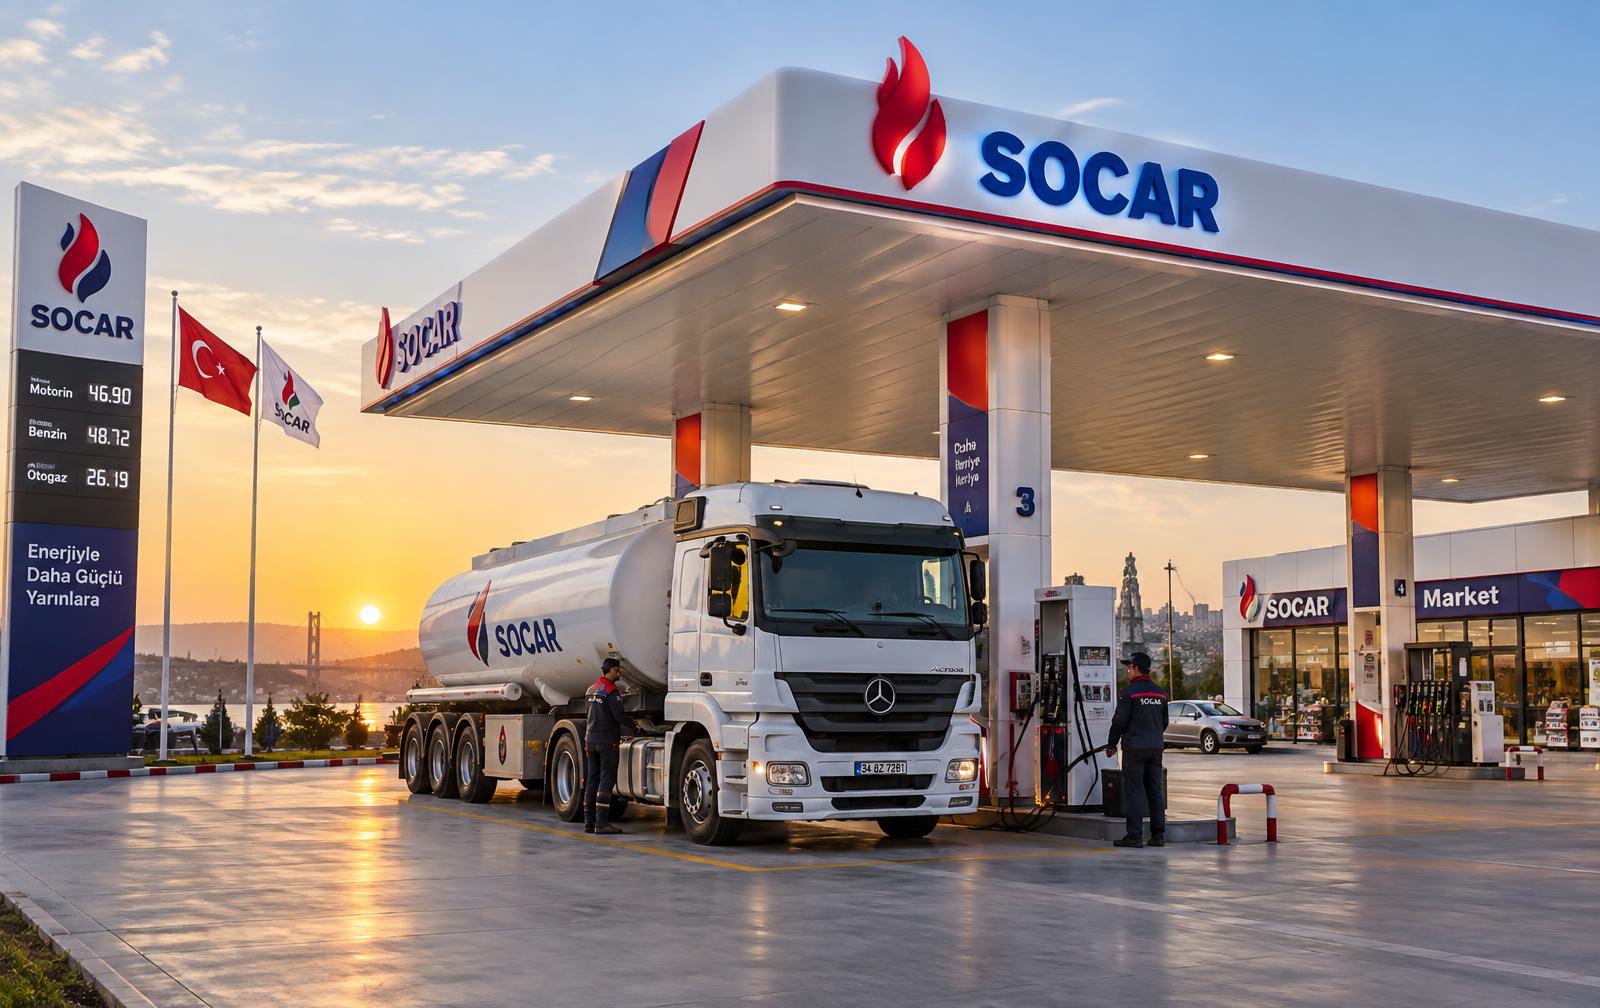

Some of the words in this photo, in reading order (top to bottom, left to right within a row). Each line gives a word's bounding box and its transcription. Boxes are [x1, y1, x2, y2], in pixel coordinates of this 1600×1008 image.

[979, 131, 1219, 232] SOCAR
[31, 304, 134, 339] SOCAR
[395, 301, 460, 372] SOCAR
[29, 383, 73, 399] Motorin
[89, 384, 132, 405] 46.90
[28, 425, 67, 441] Benzin
[87, 426, 130, 447] 48.72
[27, 469, 68, 484] Otogaz
[86, 468, 129, 489] 26.19
[1016, 487, 1035, 517] 3
[27, 543, 100, 565] Enerjiyle
[27, 566, 71, 584] Daha
[26, 590, 100, 607] Yarınlara
[1266, 596, 1329, 619] SOCAR
[1423, 585, 1499, 609] Market
[495, 618, 562, 657] SOCAR
[861, 763, 871, 773] 34
